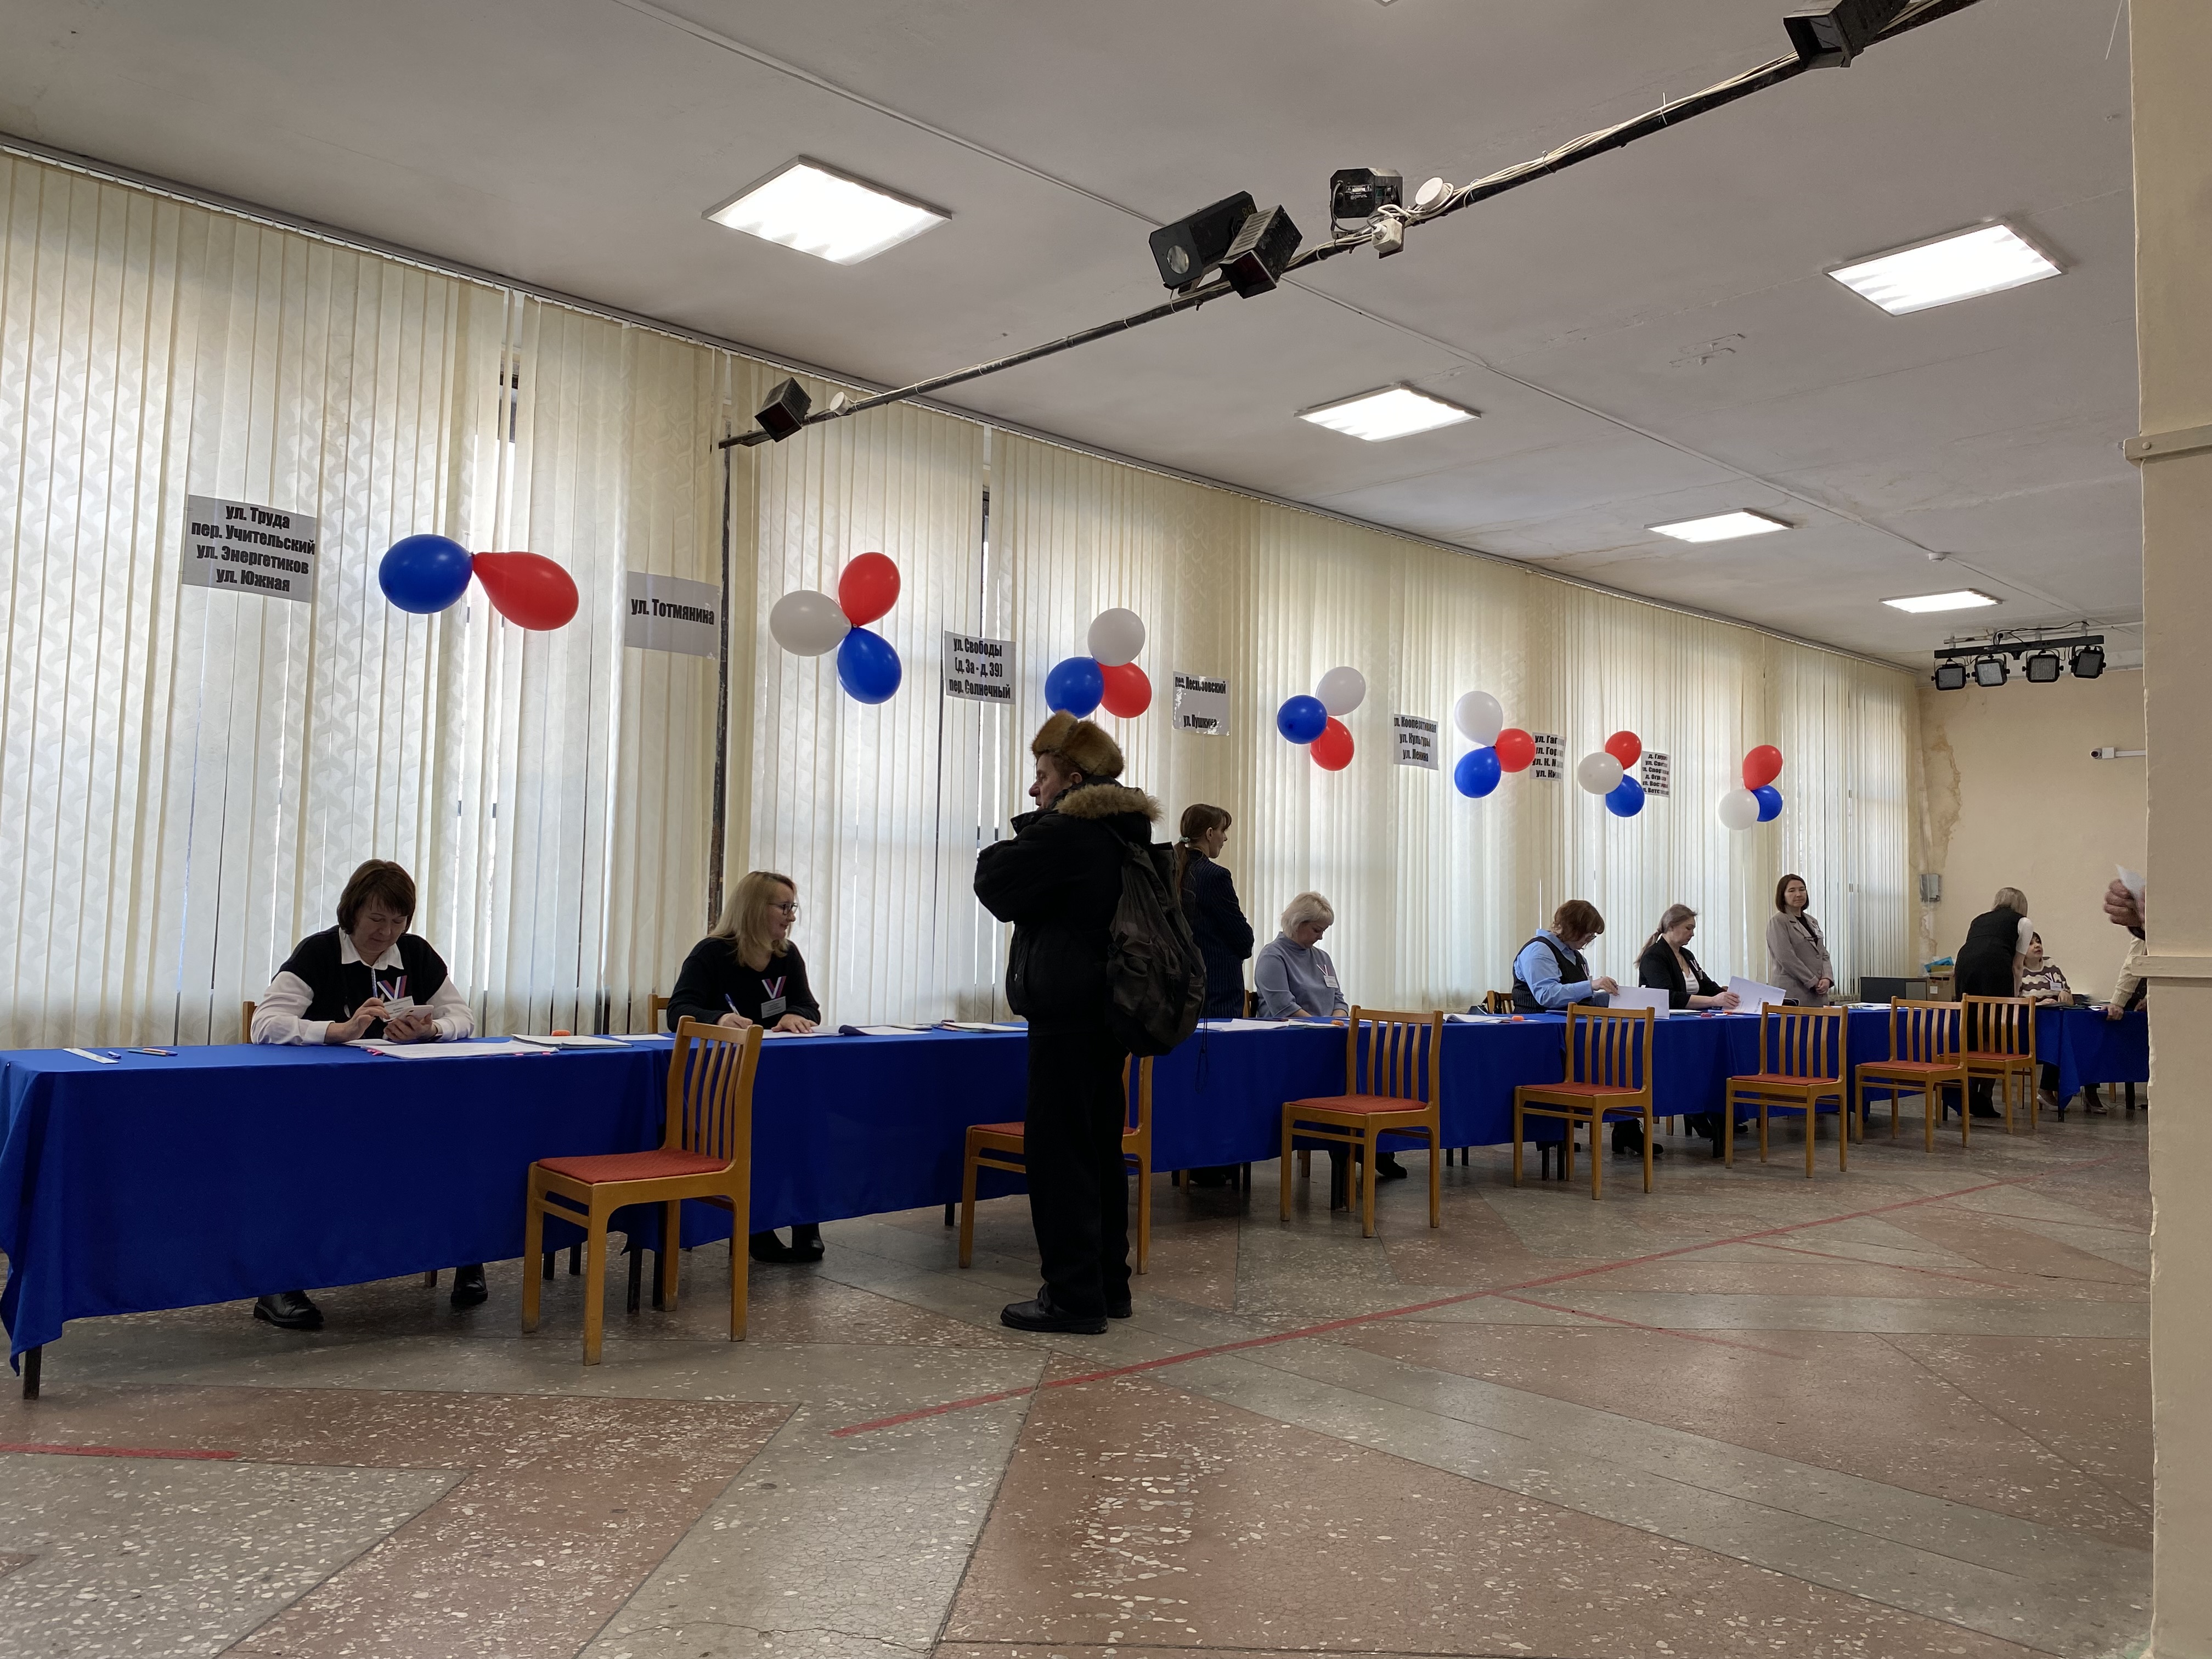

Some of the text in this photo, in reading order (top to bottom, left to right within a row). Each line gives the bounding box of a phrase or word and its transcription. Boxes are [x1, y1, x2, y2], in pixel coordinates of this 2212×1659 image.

[225, 505, 290, 529] ул. Труда
[191, 522, 315, 555] пер. Учительский
[196, 544, 309, 574] ул. Энергетиков
[216, 568, 290, 592] ул. Южная
[631, 598, 715, 625] ул. Тотмянина
[953, 637, 1002, 658] ул. Свободы
[989, 662, 1003, 678] 39)
[949, 679, 1011, 699] пер. Солнечный
[1183, 715, 1192, 727] ул.
[1400, 733, 1408, 744] ул.
[1534, 735, 1545, 743] ул.
[1402, 749, 1411, 760] ул.
[1536, 769, 1547, 777] ул.
